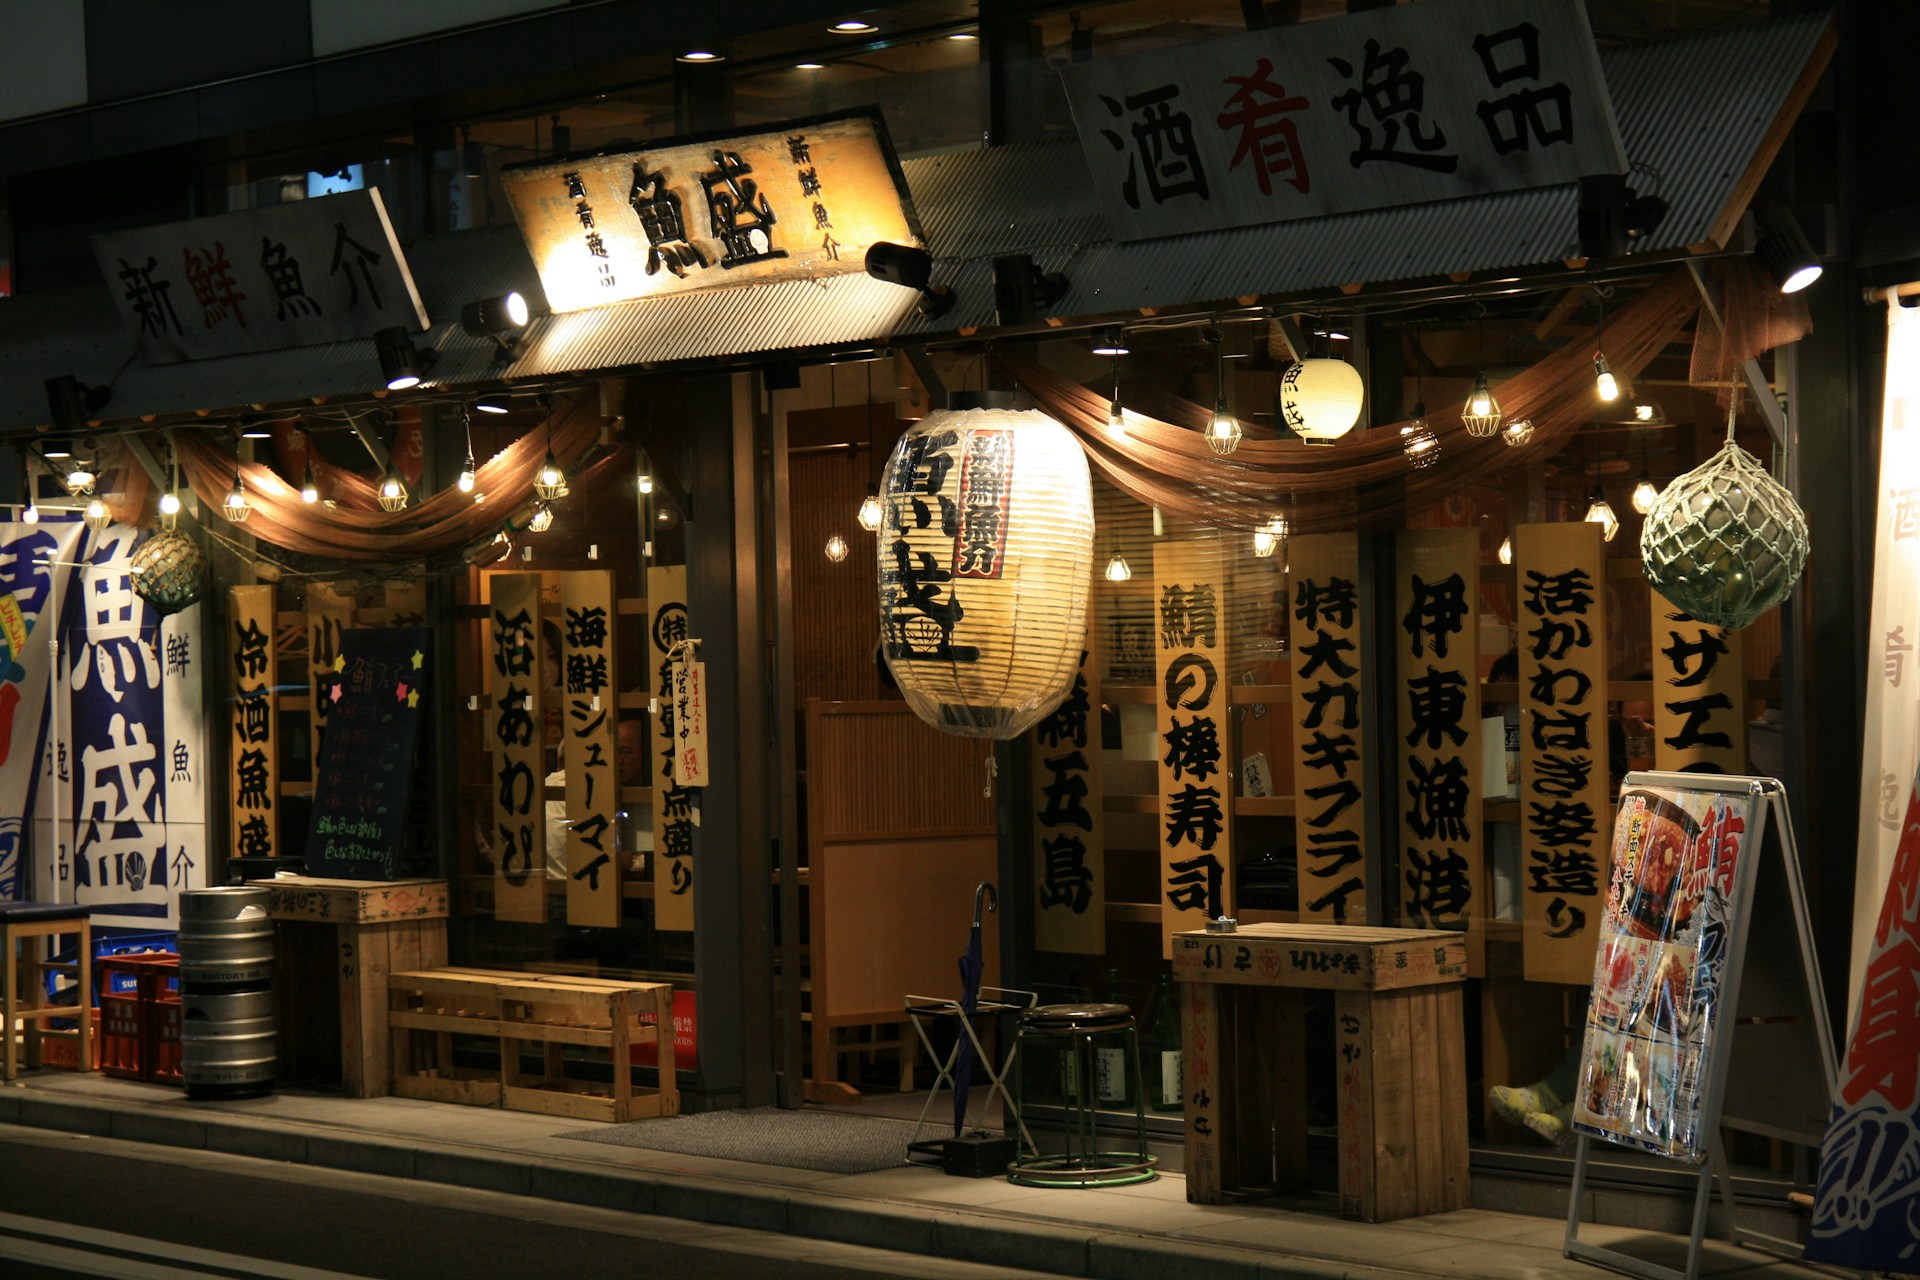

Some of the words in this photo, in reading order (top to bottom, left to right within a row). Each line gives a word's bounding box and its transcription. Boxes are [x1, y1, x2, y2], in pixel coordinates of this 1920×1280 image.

[629, 149, 791, 280] 魚盛
[1100, 22, 1573, 210] 酒肴逸品
[118, 221, 383, 338] 新鮮魚介
[235, 618, 272, 858] 冷酒魚盛
[565, 606, 611, 891] 海鮮シューマイ
[675, 667, 691, 750] 営業中
[1037, 648, 1093, 914] 崎五島
[1295, 576, 1365, 925] 特大カキフライ
[1402, 572, 1470, 931] 伊東漁港
[1523, 568, 1599, 939] 活かわはぎ姿造り
[1662, 611, 1734, 775] ザエ
